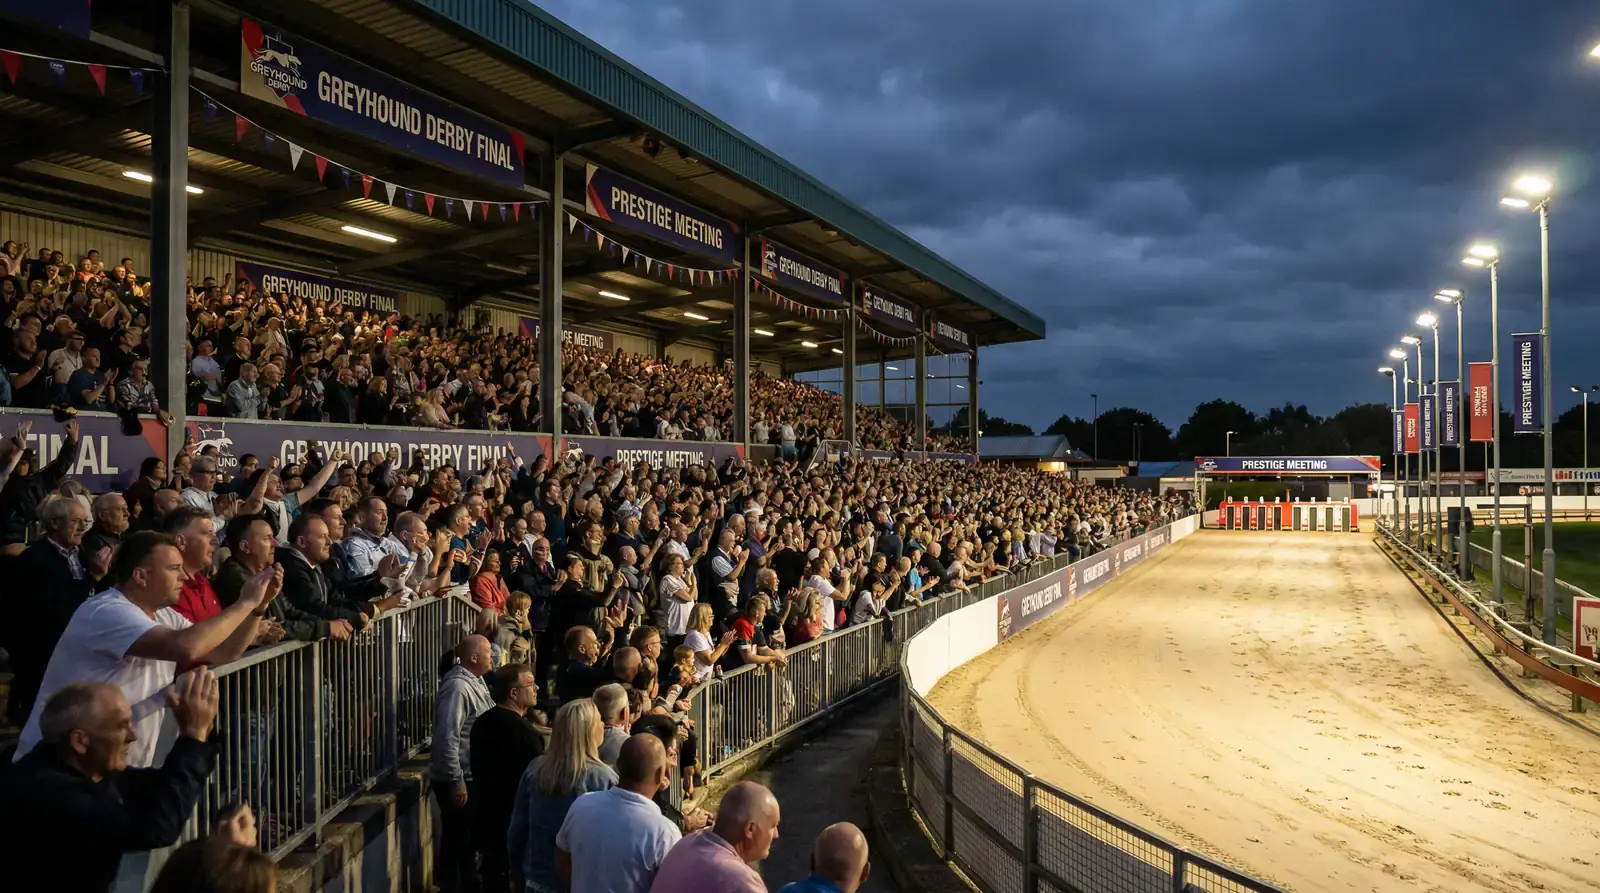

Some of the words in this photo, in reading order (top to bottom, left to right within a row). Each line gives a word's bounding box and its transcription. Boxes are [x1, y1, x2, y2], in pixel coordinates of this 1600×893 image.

[250, 61, 308, 90] GREYHOUND
[318, 71, 421, 136] GREYHOUND
[426, 113, 474, 155] DERBY
[477, 133, 515, 171] FINAL
[611, 186, 672, 230] PRESTIGE
[675, 211, 723, 249] MEETING
[262, 274, 331, 302] GREYHOUND
[334, 287, 367, 308] DERBY
[370, 294, 398, 313] FINAL
[574, 332, 604, 350] MEETING
[1521, 341, 1533, 379] MEETING
[617, 449, 664, 471] PRESTIGE
[666, 450, 704, 469] MEETING
[1242, 460, 1285, 470] PRESTIGE
[1286, 460, 1328, 470] MEETING
